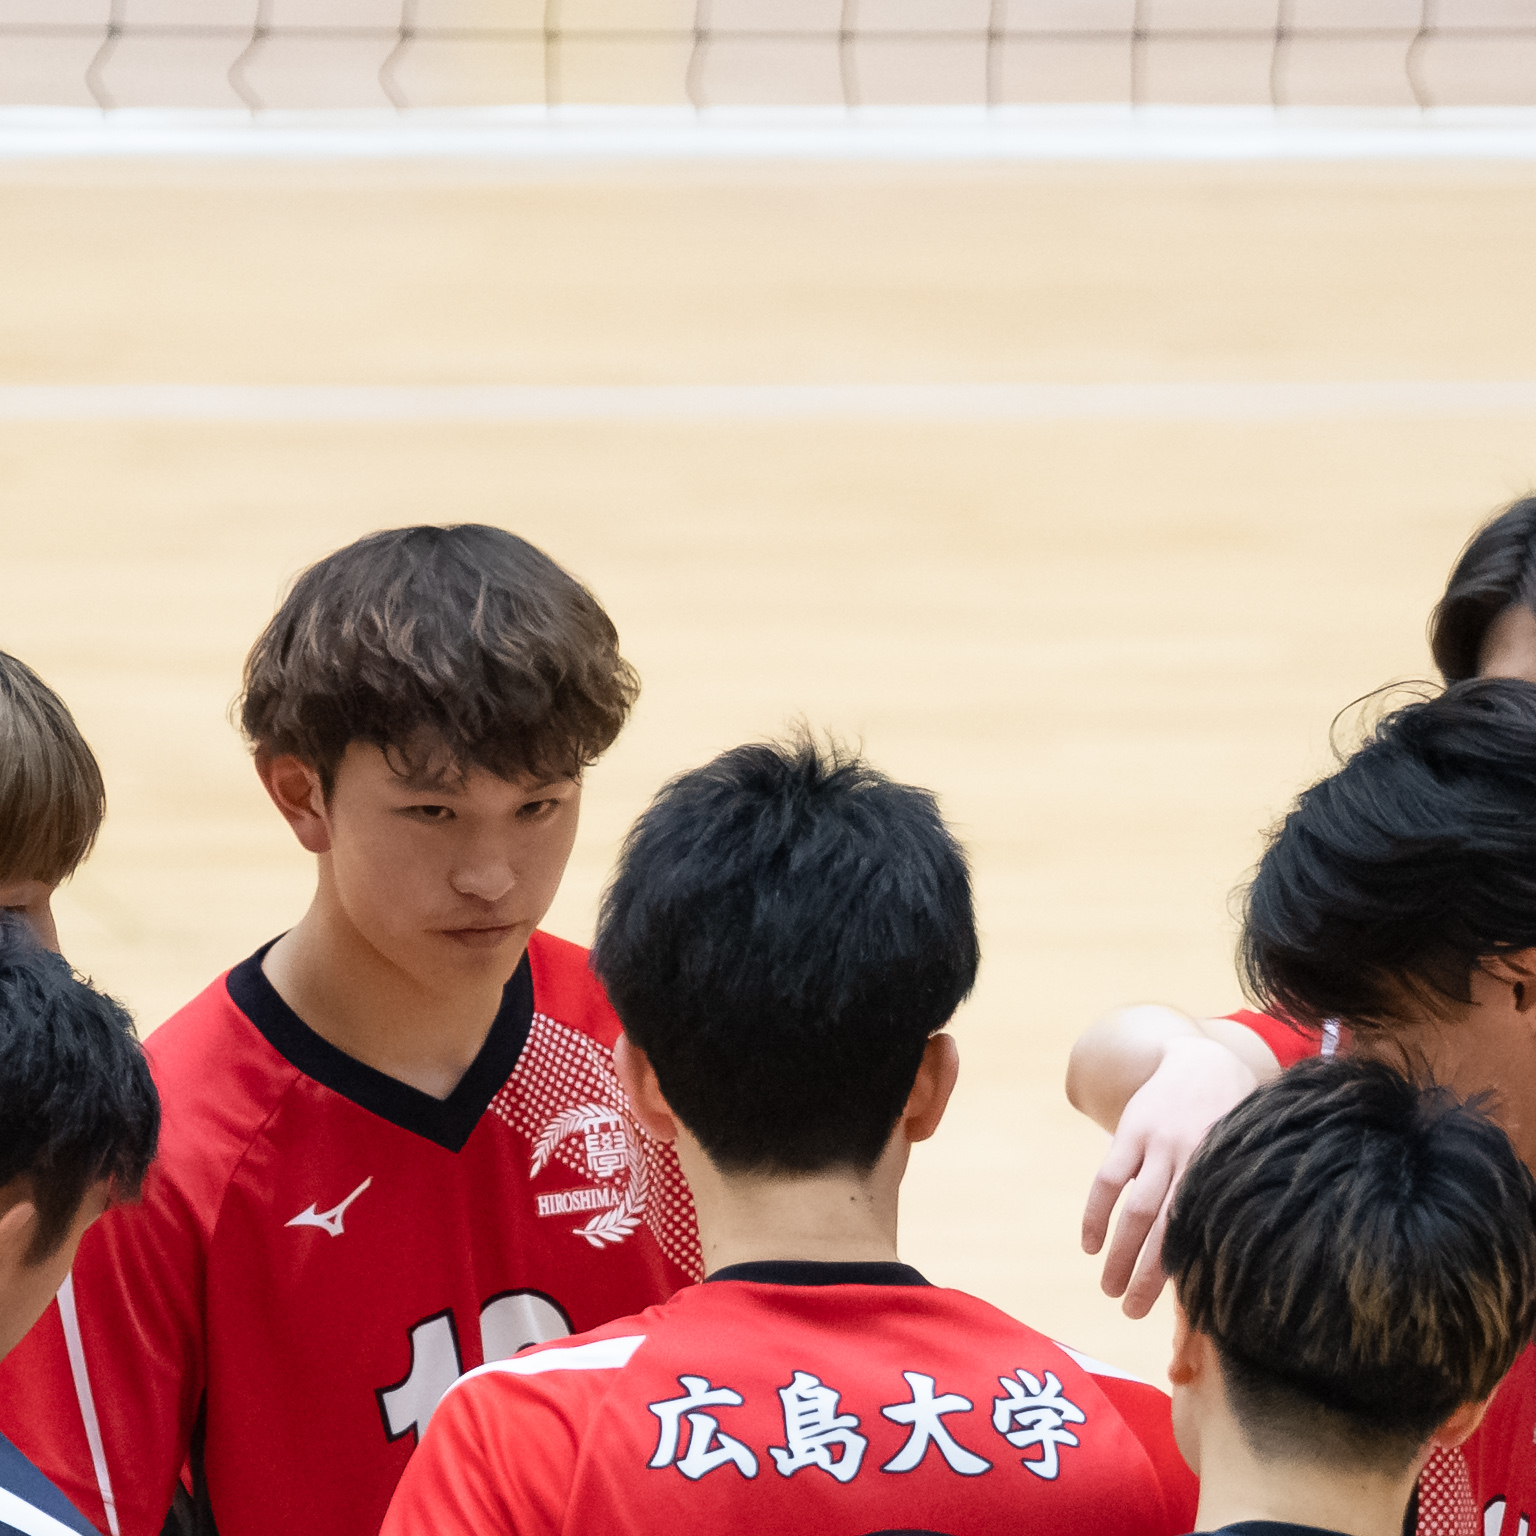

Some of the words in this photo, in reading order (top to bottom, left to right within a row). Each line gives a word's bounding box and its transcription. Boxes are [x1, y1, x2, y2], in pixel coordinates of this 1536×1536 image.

[537, 1187, 622, 1217] HIROSHIMA
[647, 1368, 1087, 1483] 広島大学
